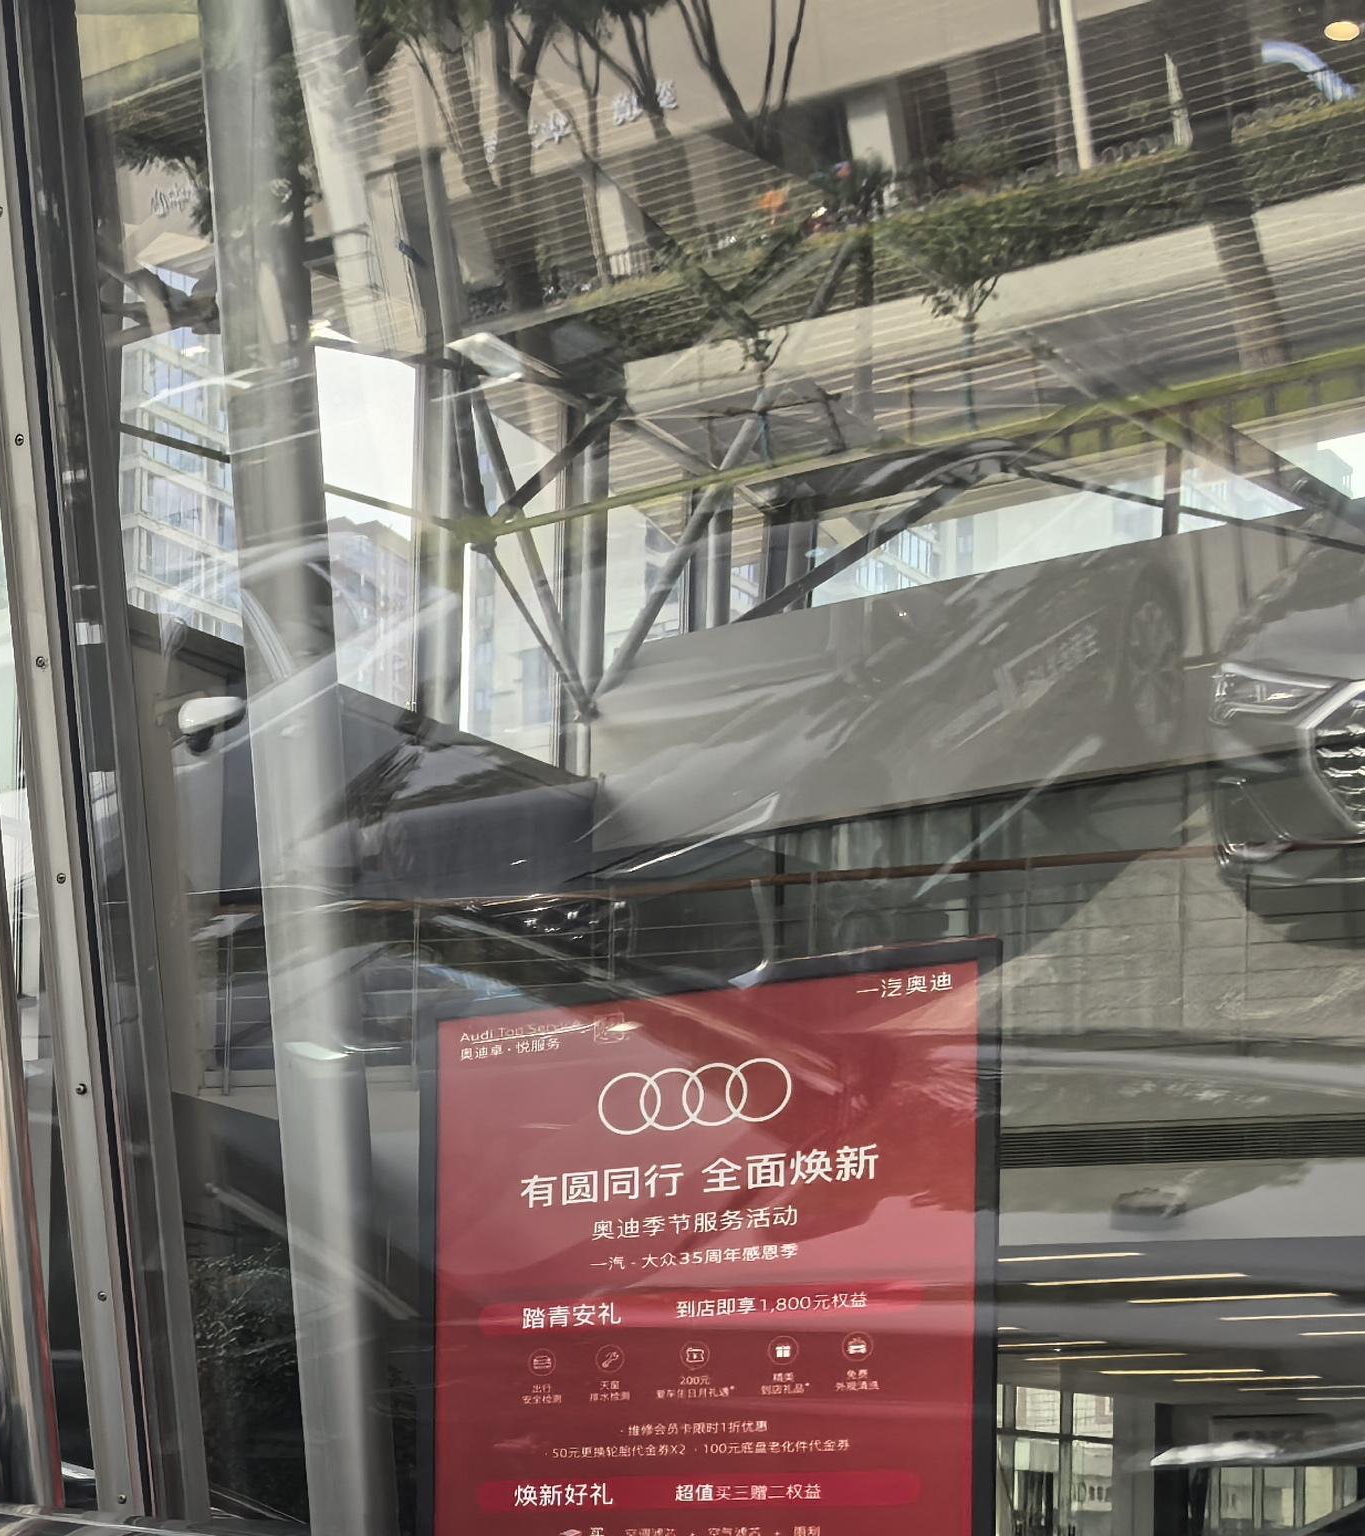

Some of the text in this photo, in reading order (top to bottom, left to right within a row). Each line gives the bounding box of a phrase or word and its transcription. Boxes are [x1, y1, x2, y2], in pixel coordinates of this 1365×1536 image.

[857, 971, 954, 999] 一汽奥迪
[520, 1144, 879, 1210] 有圆同行 全面焕新
[591, 1205, 799, 1241] 奥迪季节服务活动
[521, 1290, 868, 1329] 踏青安礼 到店即享1,800元权益
[514, 1482, 822, 1508] 焕新好礼 超值买三赠二权益
